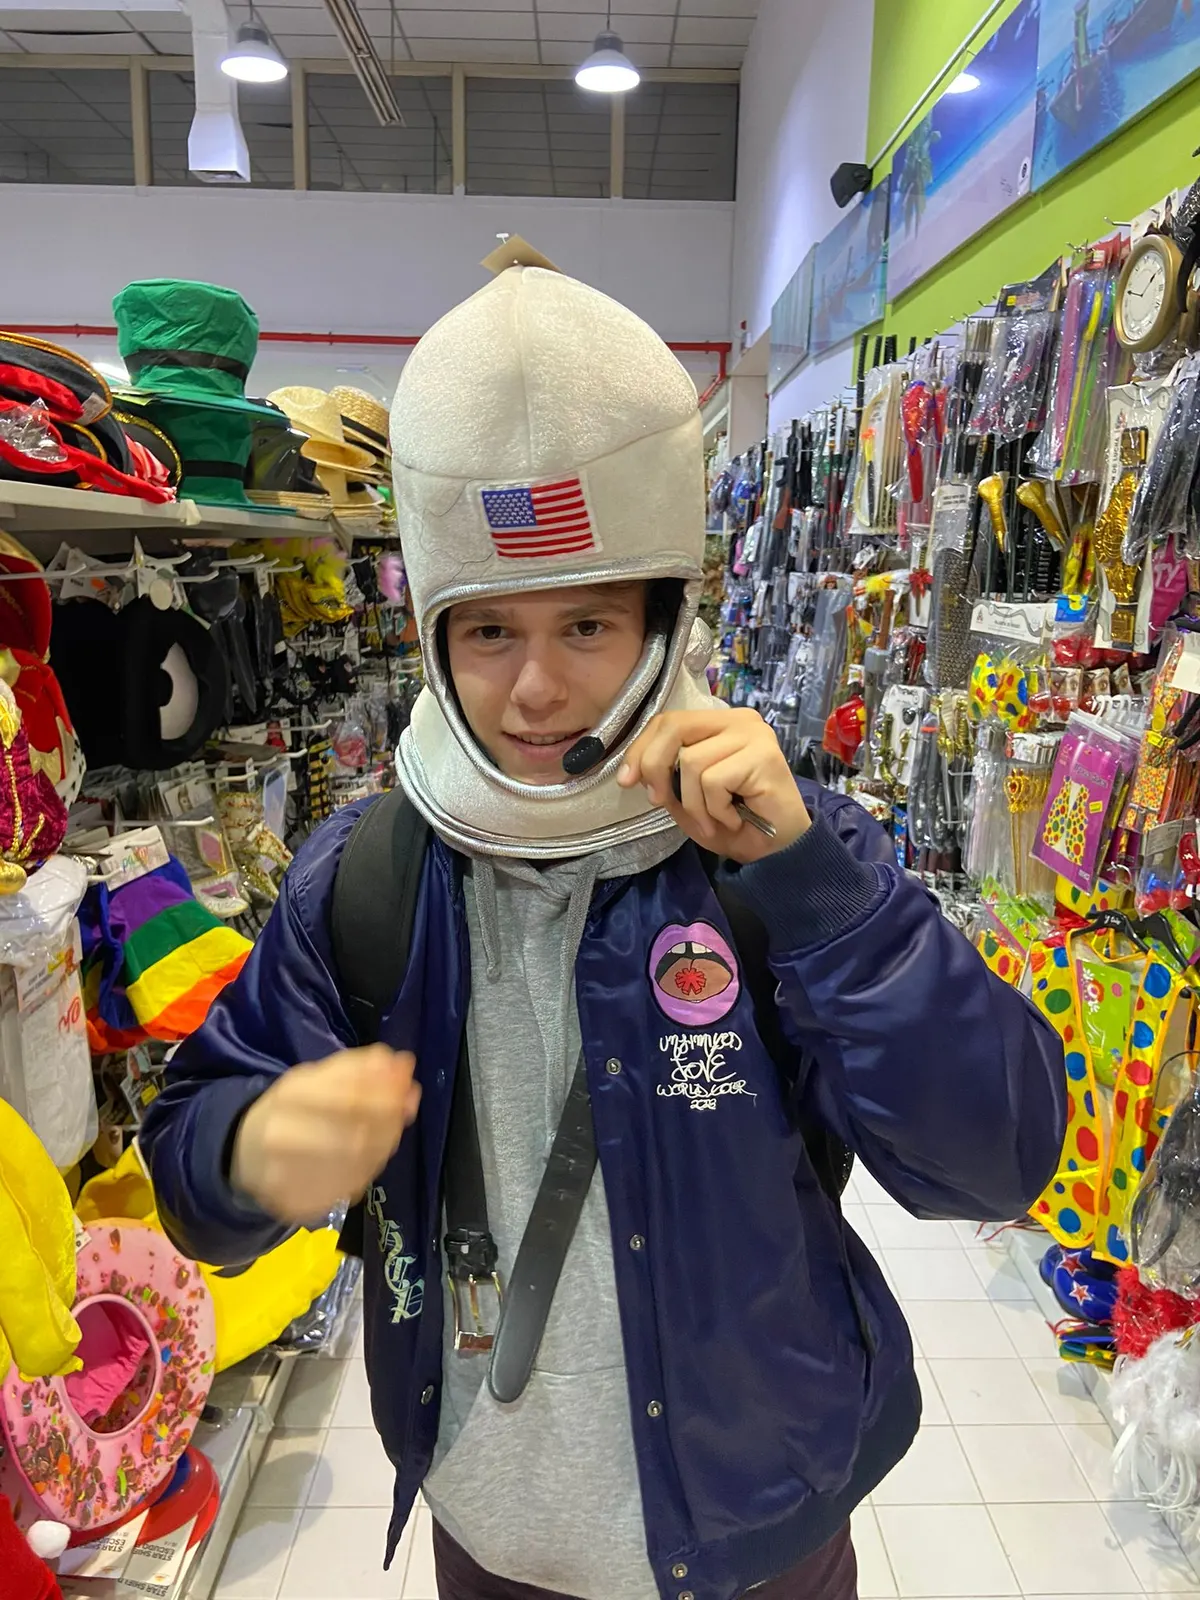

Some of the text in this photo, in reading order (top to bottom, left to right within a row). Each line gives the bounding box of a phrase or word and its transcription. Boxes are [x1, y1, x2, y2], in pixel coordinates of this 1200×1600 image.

[101, 1545, 124, 1553] STAR
[132, 1548, 173, 1562] STAR SHIE
[145, 1583, 168, 1597] STAR
